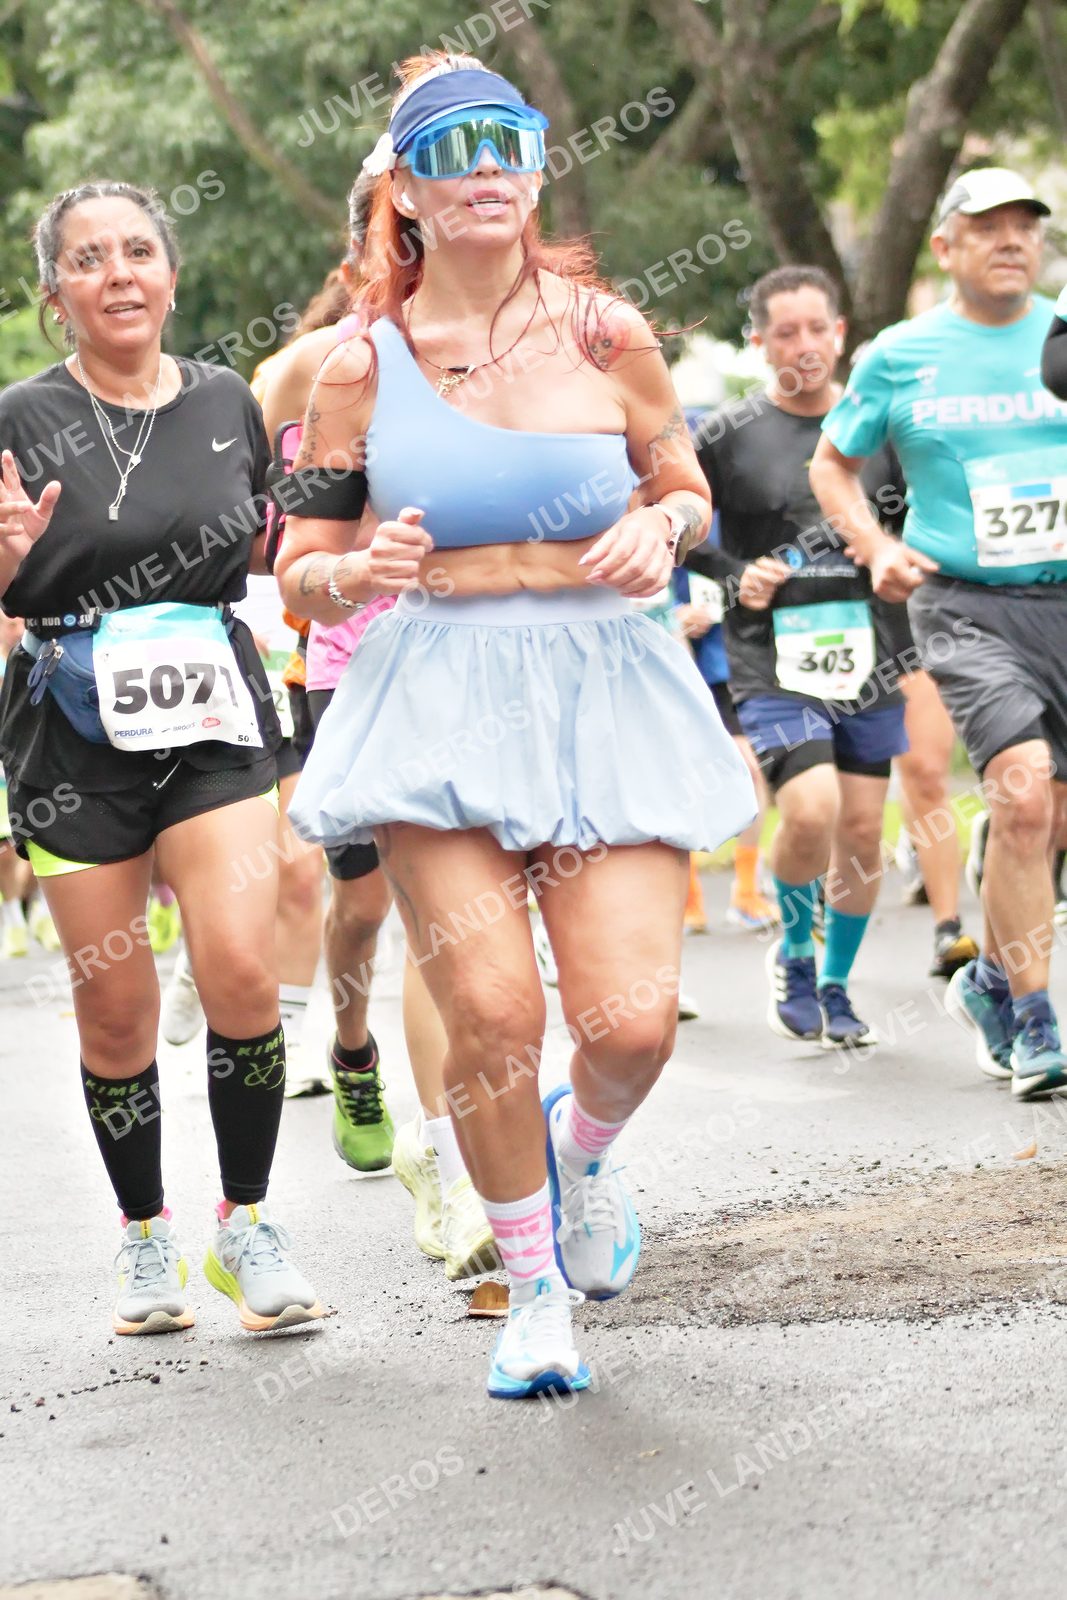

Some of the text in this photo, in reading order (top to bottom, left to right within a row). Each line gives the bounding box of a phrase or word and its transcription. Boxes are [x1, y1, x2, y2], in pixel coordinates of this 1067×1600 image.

[982, 500, 1067, 538] 327
[42, 616, 61, 627] RUN
[798, 648, 855, 674] 303
[114, 727, 154, 738] PERDURA
[236, 1030, 285, 1057] KIME
[86, 1079, 140, 1097] KIME
